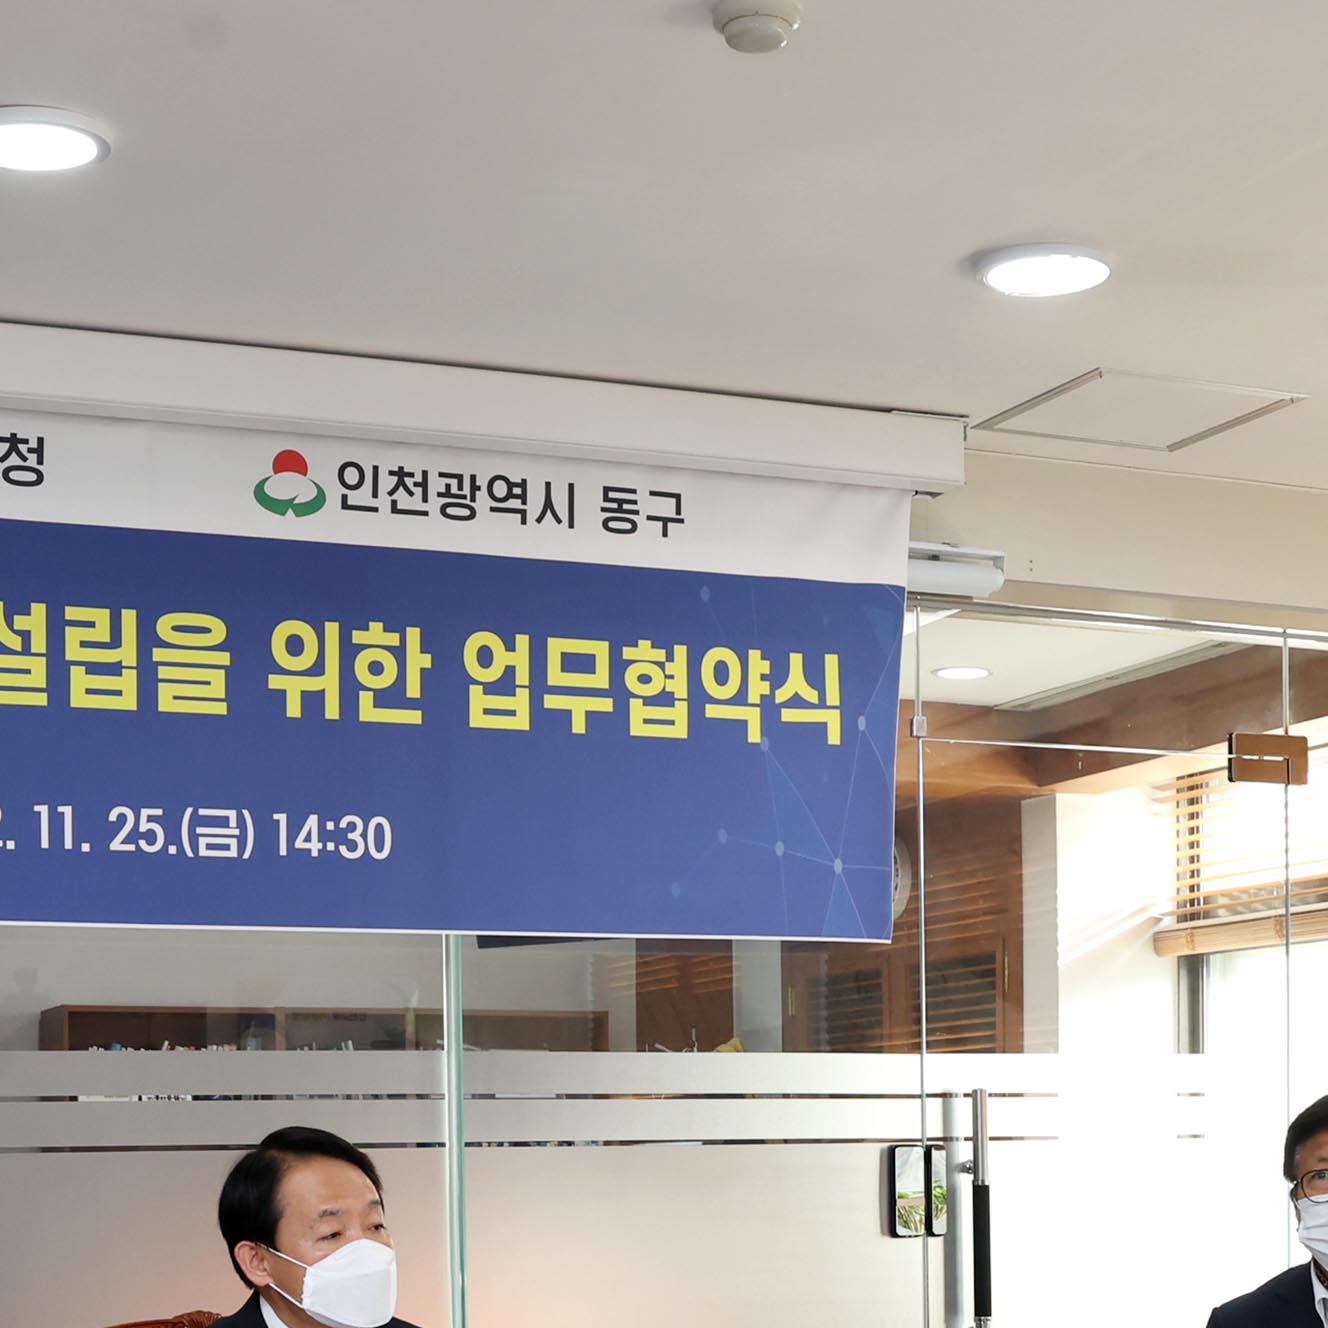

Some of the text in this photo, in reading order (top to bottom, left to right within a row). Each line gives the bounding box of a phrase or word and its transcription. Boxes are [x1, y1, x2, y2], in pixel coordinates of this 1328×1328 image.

[337, 461, 685, 538] 인천광역시 동구
[268, 620, 432, 724] 위한
[464, 631, 842, 745] 업무협약식
[33, 804, 91, 853] 11.
[108, 806, 255, 860] 25.(금)
[272, 813, 392, 860] 14:30
